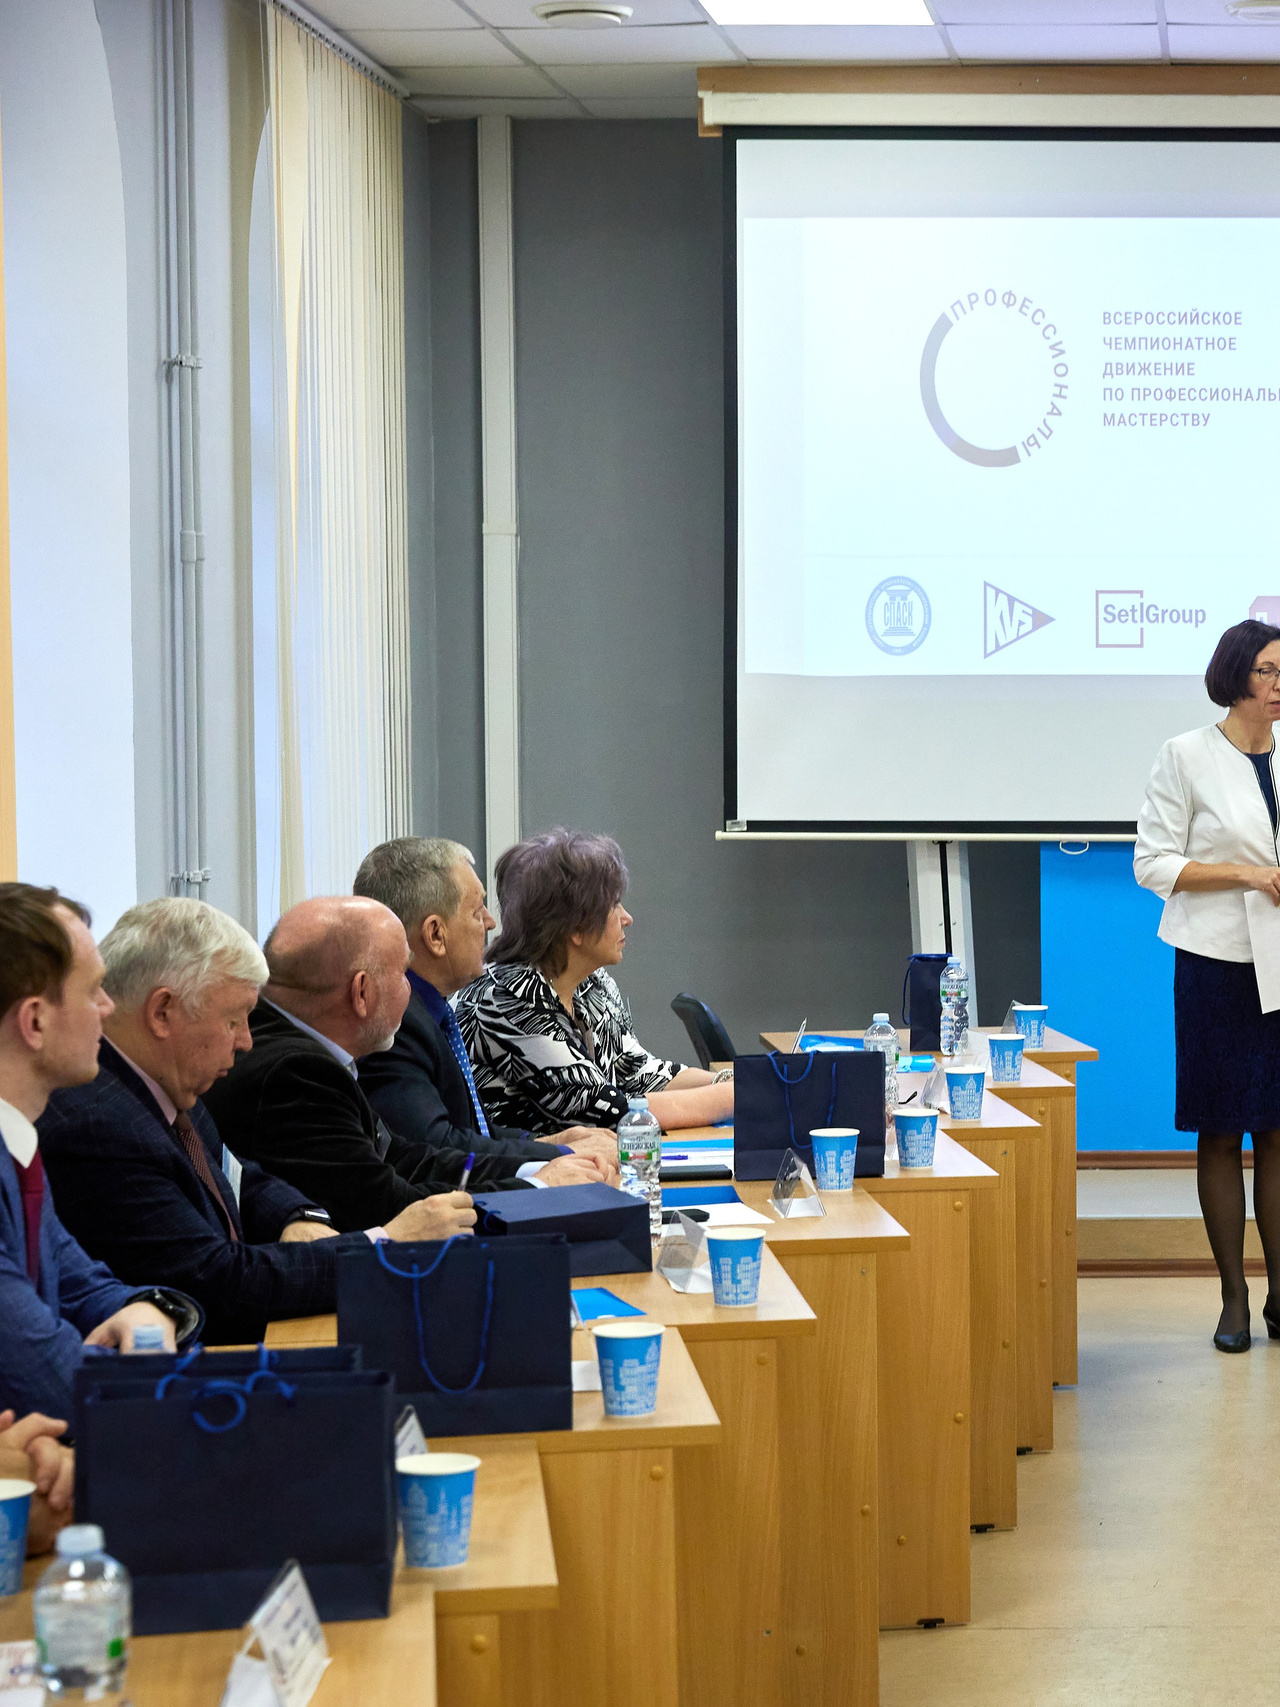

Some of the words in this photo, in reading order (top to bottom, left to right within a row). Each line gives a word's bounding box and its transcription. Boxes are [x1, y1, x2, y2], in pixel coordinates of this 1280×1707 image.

[1102, 308, 1243, 326] ВСЕРОССИЙСКОЕ
[1102, 336, 1237, 351] ЧЕМПИОНАТНОЕ
[950, 288, 1069, 458] ПРОФЕССИОНАЛЫ
[1102, 361, 1196, 380] ДВИЖЕНИЕ
[1102, 387, 1125, 402] ПО
[1102, 412, 1211, 428] МАСТЕРСТВУ
[883, 601, 913, 627] СПАСК
